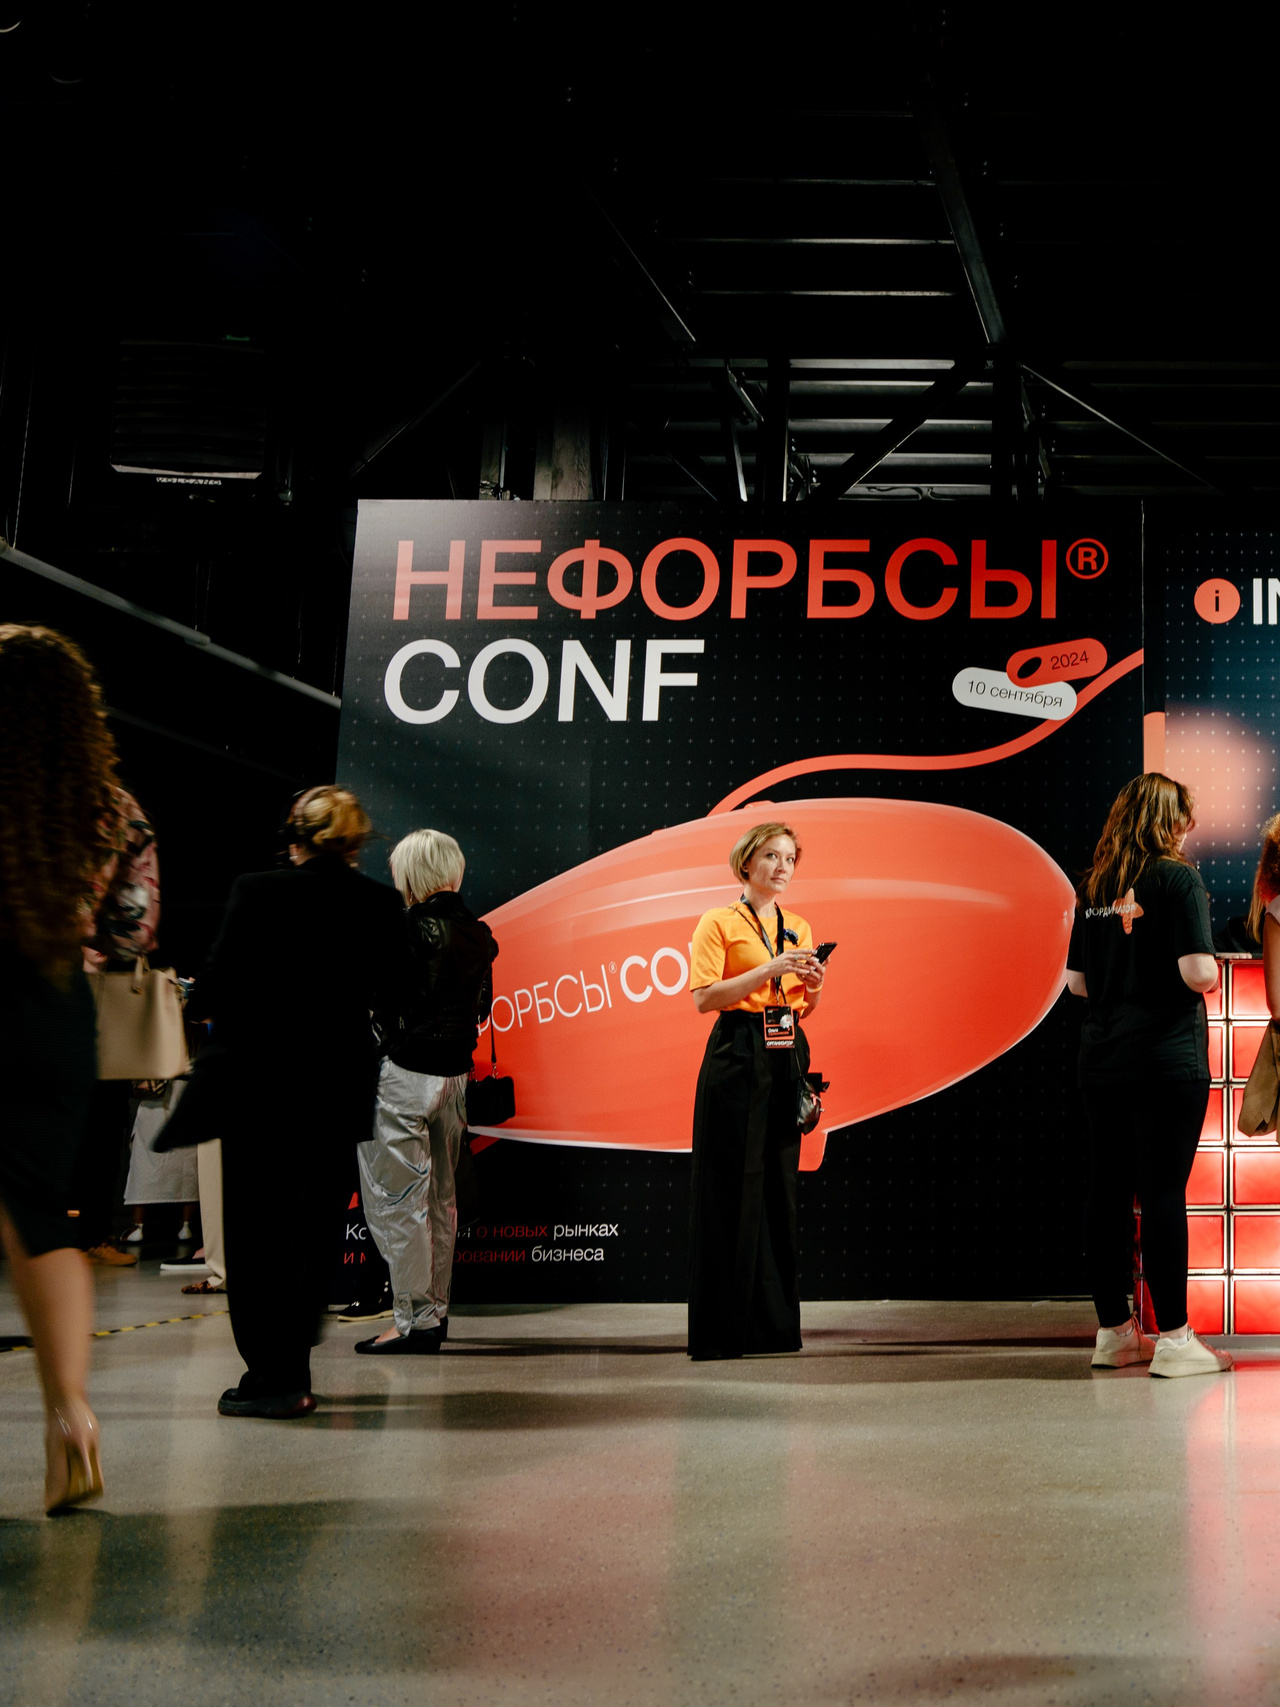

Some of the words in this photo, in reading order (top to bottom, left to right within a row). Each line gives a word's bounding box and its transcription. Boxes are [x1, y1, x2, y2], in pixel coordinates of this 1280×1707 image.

[156, 476, 222, 486] VOLCANO
[1050, 650, 1089, 670] 2024
[384, 638, 705, 724] CONF
[968, 680, 986, 695] 10
[990, 686, 1063, 708] сентября
[1085, 903, 1137, 919] КОРДИНАТОР
[619, 942, 693, 1003] CO
[493, 1225, 548, 1239] новых
[553, 1222, 619, 1241] рынках
[531, 1245, 605, 1262] бизнеса
